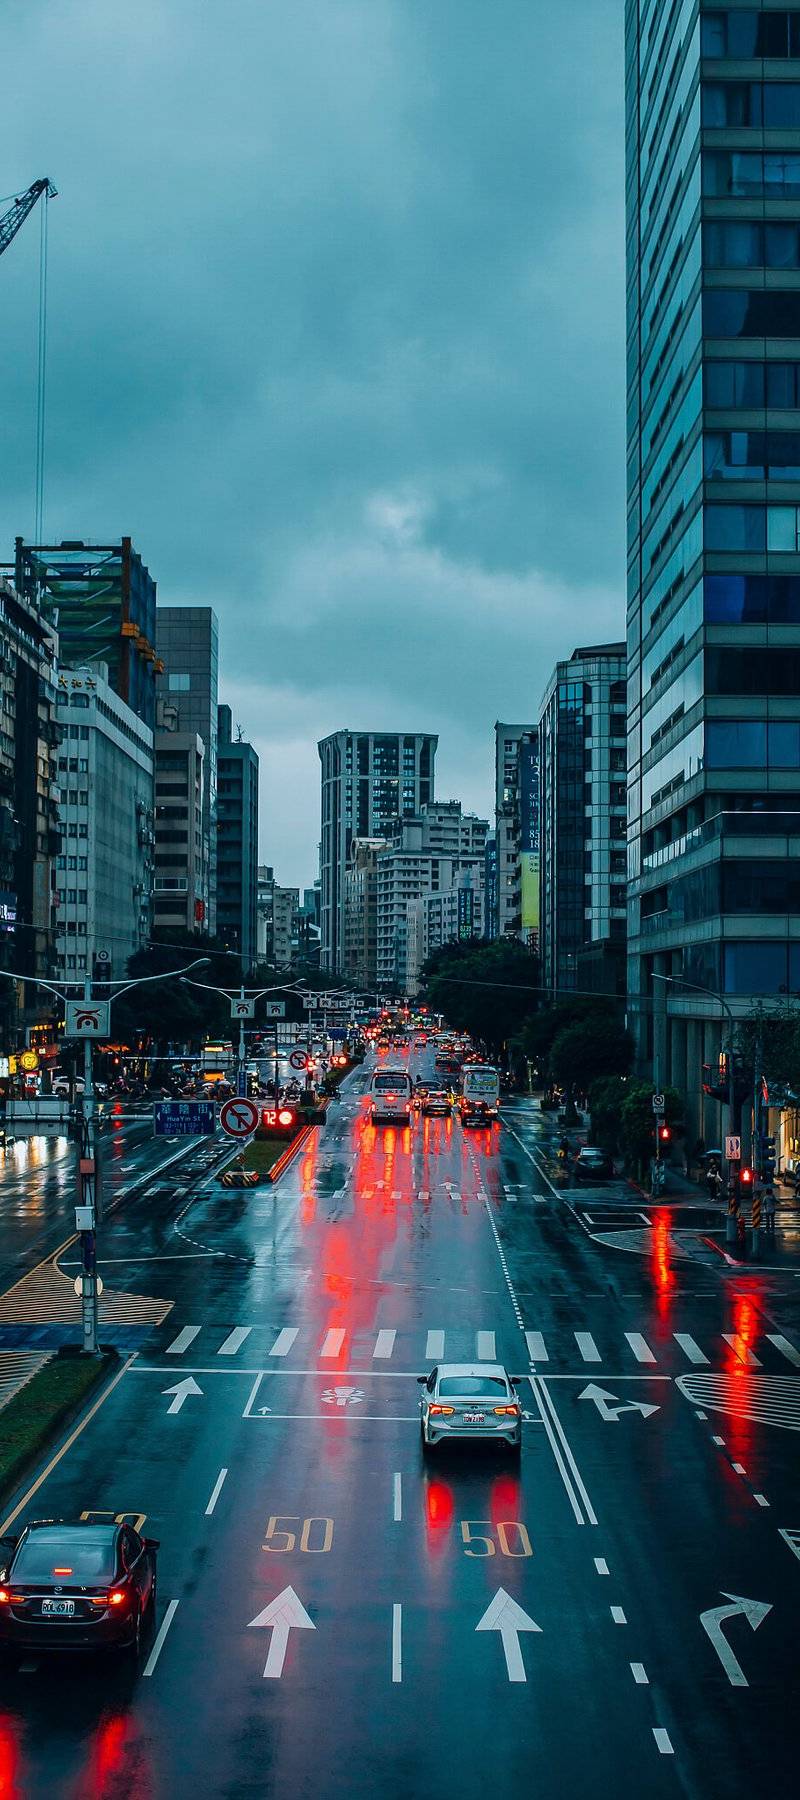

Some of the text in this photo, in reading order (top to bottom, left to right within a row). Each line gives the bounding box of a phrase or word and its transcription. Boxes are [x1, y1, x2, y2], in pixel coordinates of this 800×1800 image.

[263, 1111, 277, 1125] 72
[261, 1516, 334, 1552] 50
[461, 1520, 533, 1557] 50
